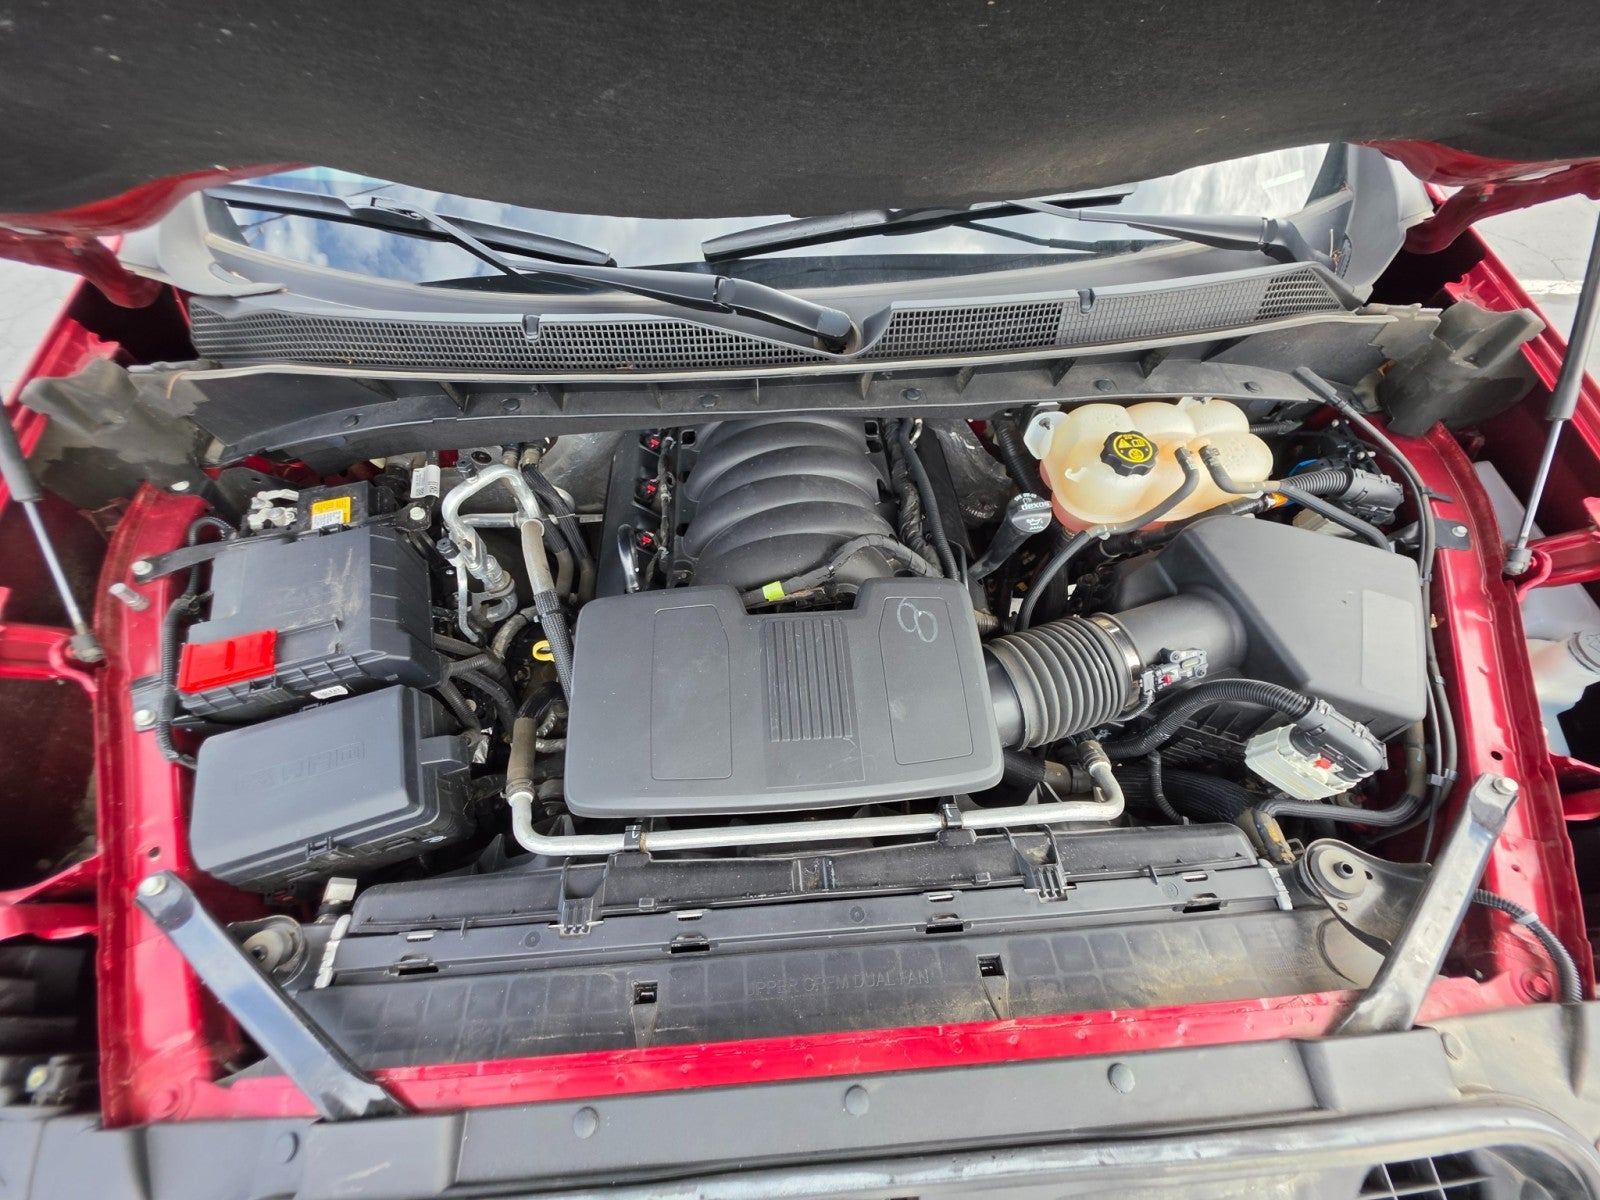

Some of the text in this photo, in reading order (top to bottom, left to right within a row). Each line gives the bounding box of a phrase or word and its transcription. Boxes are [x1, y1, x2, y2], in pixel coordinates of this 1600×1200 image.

[1021, 501, 1051, 511] dexos
[747, 979, 799, 996] UPPER
[854, 970, 896, 988] DUAL
[899, 968, 930, 986] FAN
